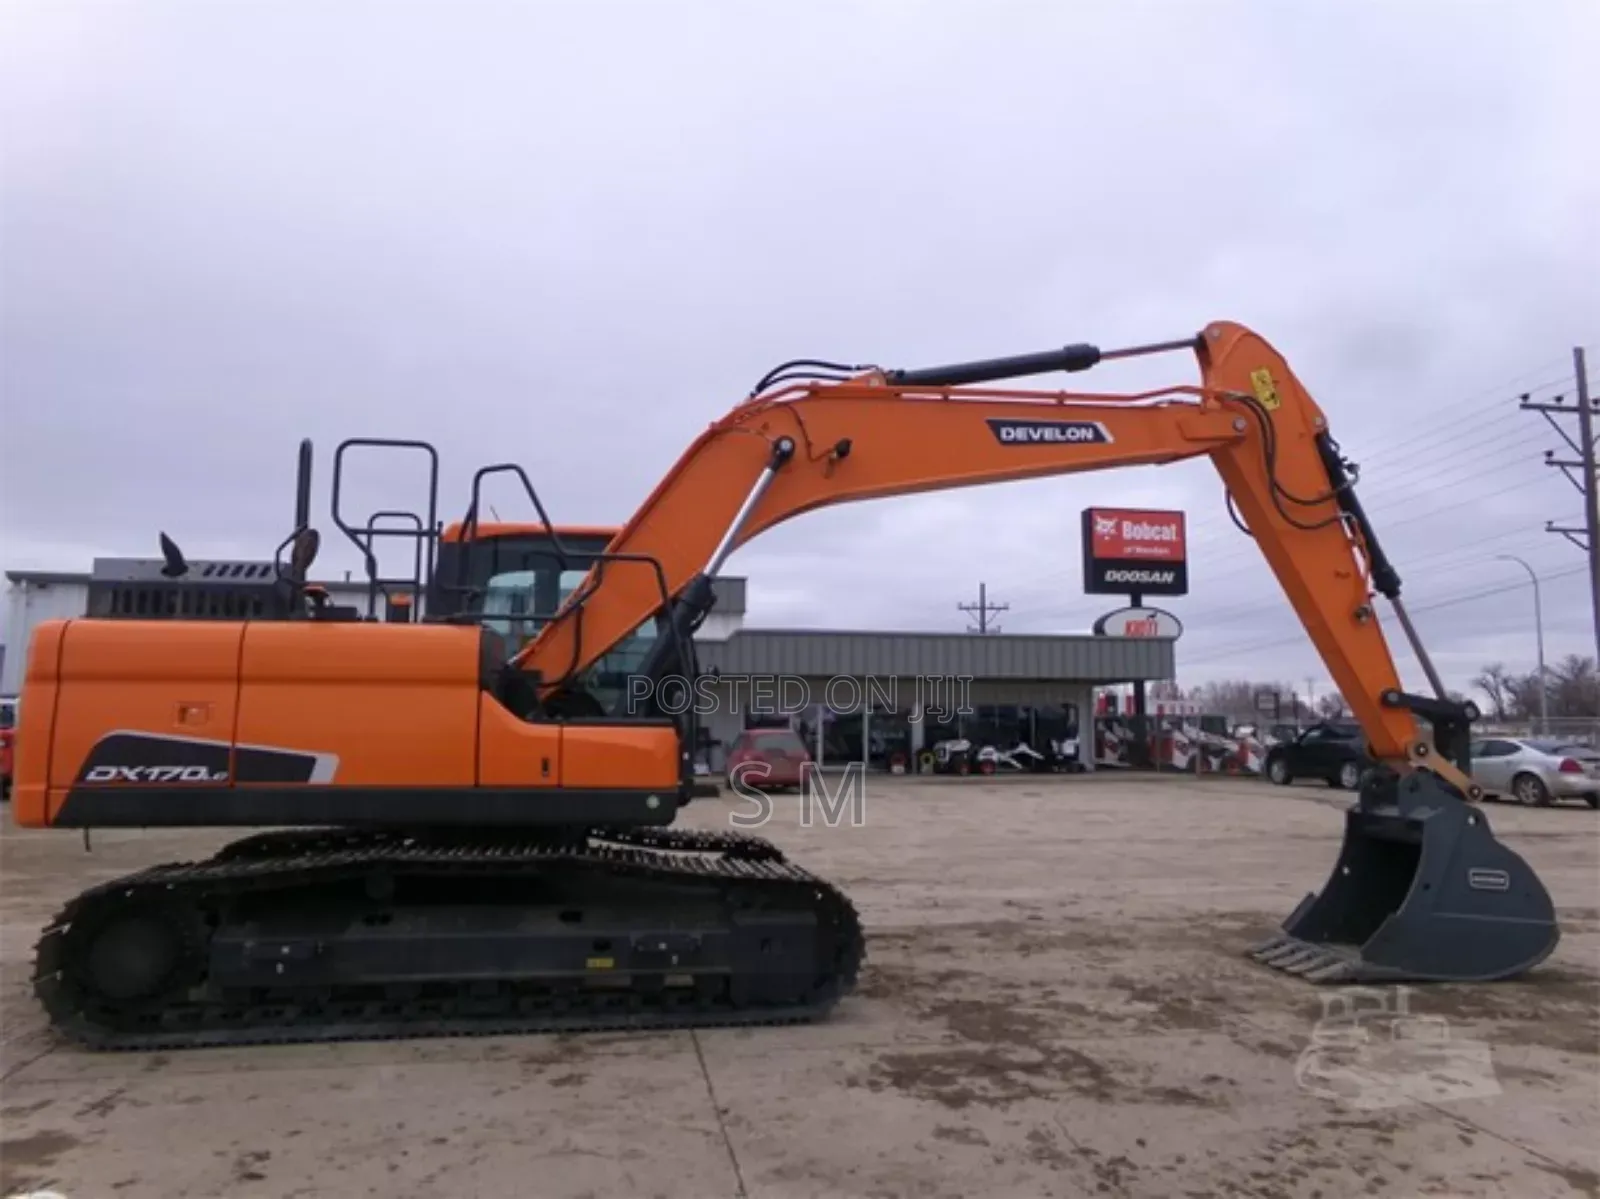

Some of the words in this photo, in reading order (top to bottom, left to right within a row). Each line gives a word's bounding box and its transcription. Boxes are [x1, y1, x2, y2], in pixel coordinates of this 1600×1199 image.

[1000, 426, 1093, 442] DEVELON
[1122, 520, 1178, 541] Bobcat
[1104, 569, 1176, 584] DOOSAN
